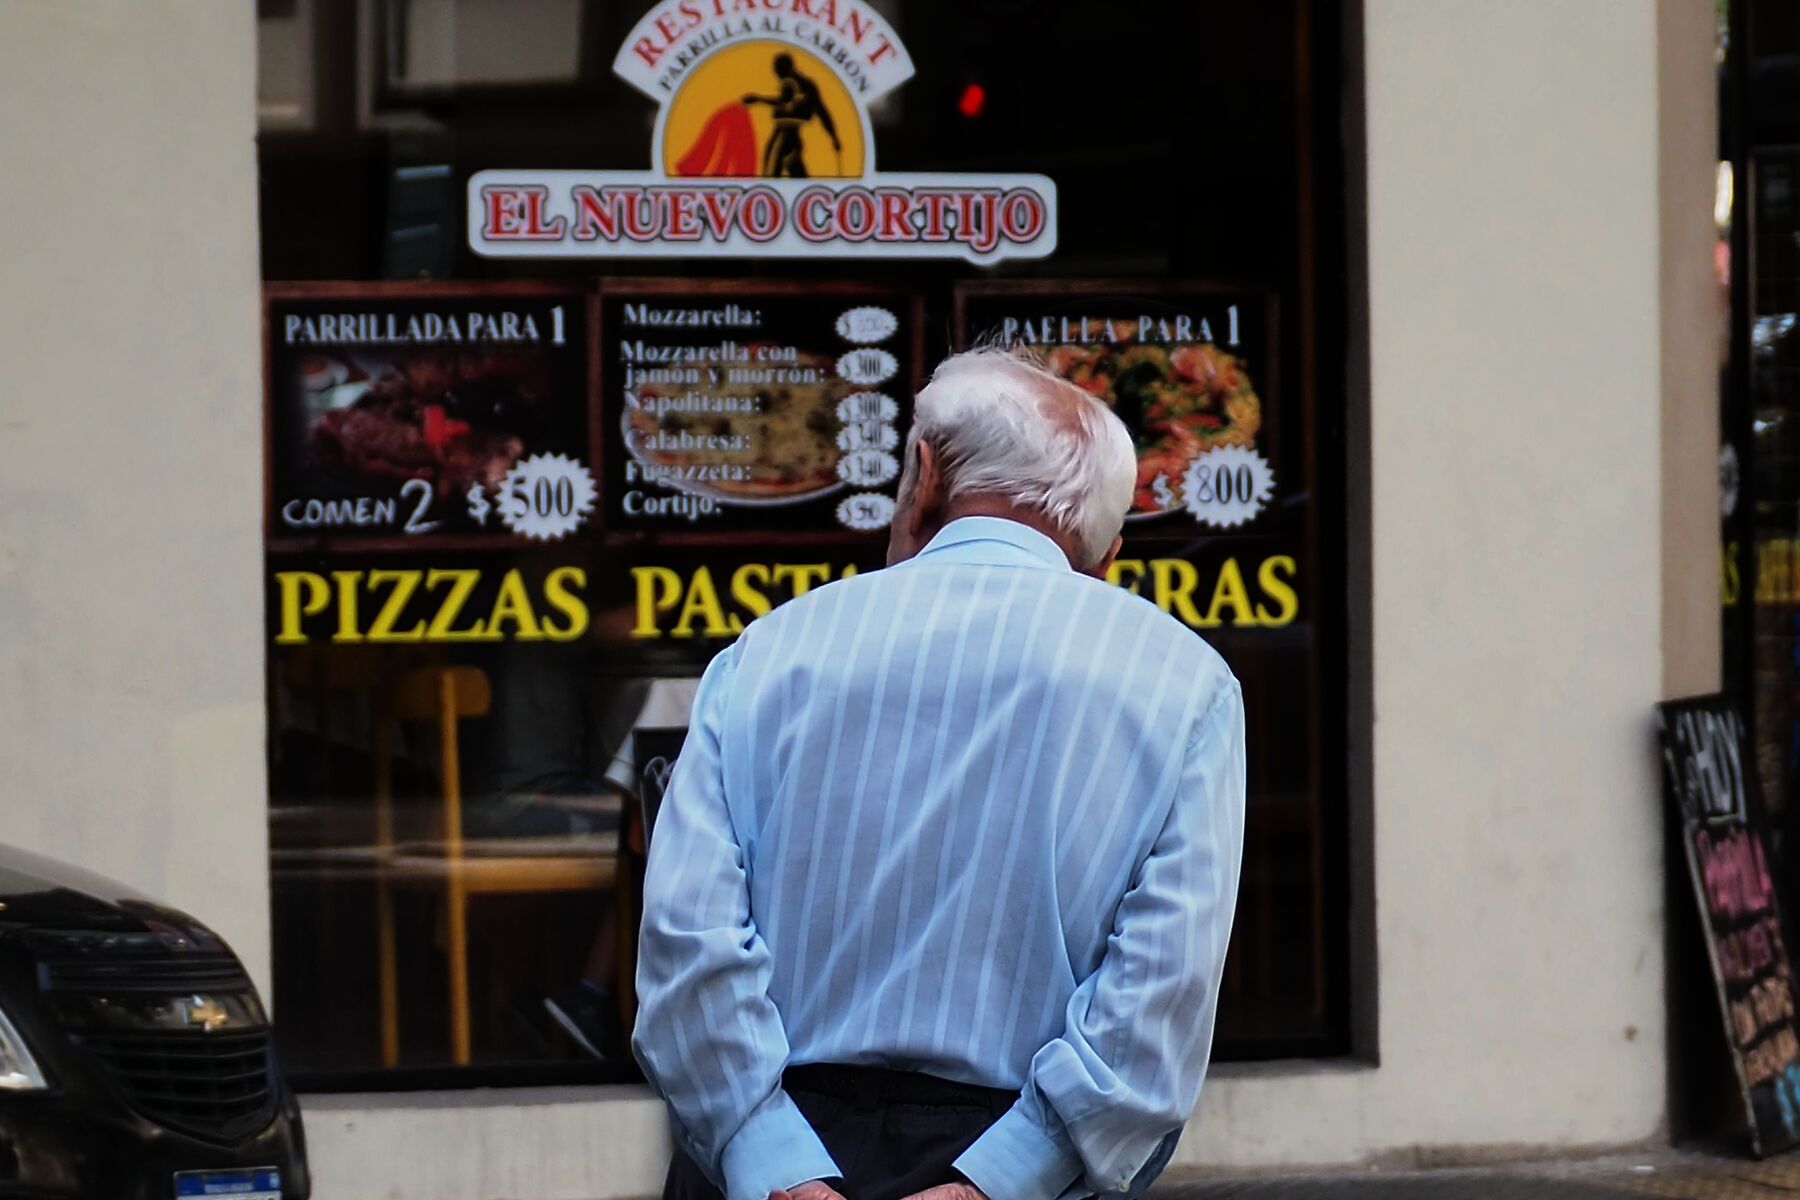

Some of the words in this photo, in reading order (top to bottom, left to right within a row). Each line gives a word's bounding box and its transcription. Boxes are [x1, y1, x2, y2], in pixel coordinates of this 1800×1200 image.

[659, 18, 752, 92] PARRILLA
[760, 16, 787, 33] AL
[794, 20, 870, 93] CARBON
[482, 185, 565, 242] EL
[572, 185, 786, 243] NUEVO
[794, 186, 1048, 254] CORTIJO
[285, 312, 462, 343] PARRILLADA
[468, 311, 540, 341] PARA
[550, 305, 567, 345] 1
[624, 303, 762, 327] Mozzarella:
[1003, 316, 1118, 344] PAELLA
[1138, 315, 1214, 343] PARA
[1227, 304, 1240, 346] 1
[620, 340, 749, 363] Mozzarella
[757, 345, 798, 362] con
[707, 368, 720, 389] y
[624, 429, 751, 450] Calabresa:
[626, 460, 751, 488] Fugazzeta:
[1195, 463, 1254, 505] 800
[282, 497, 397, 525] COMEN
[400, 478, 441, 534] 2
[511, 475, 575, 518] 500
[274, 566, 591, 643] PIZZAS
[630, 563, 858, 638] PAST
